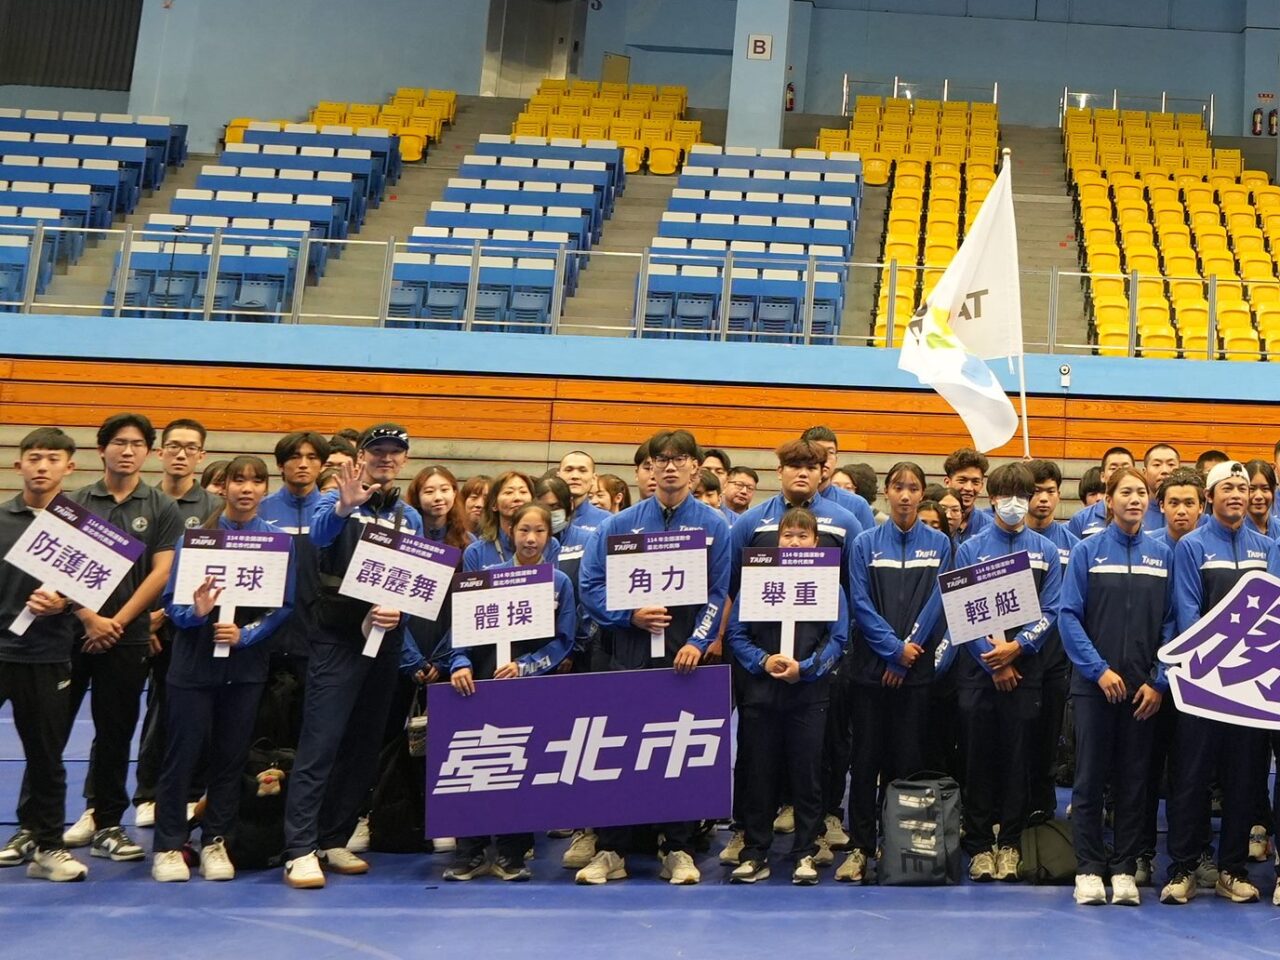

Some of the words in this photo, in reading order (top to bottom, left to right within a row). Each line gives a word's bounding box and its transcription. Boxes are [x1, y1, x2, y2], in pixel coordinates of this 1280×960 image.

[753, 39, 767, 55] B
[27, 530, 112, 590] 防護隊
[205, 565, 264, 591] 足球
[356, 558, 438, 603] 霹靂舞
[628, 565, 685, 594] 角力
[761, 581, 818, 606] 舉重
[474, 600, 533, 630] 體操
[692, 602, 719, 640] TAIPEI
[964, 588, 1020, 625] 輕艇
[432, 710, 726, 795] 臺北市
